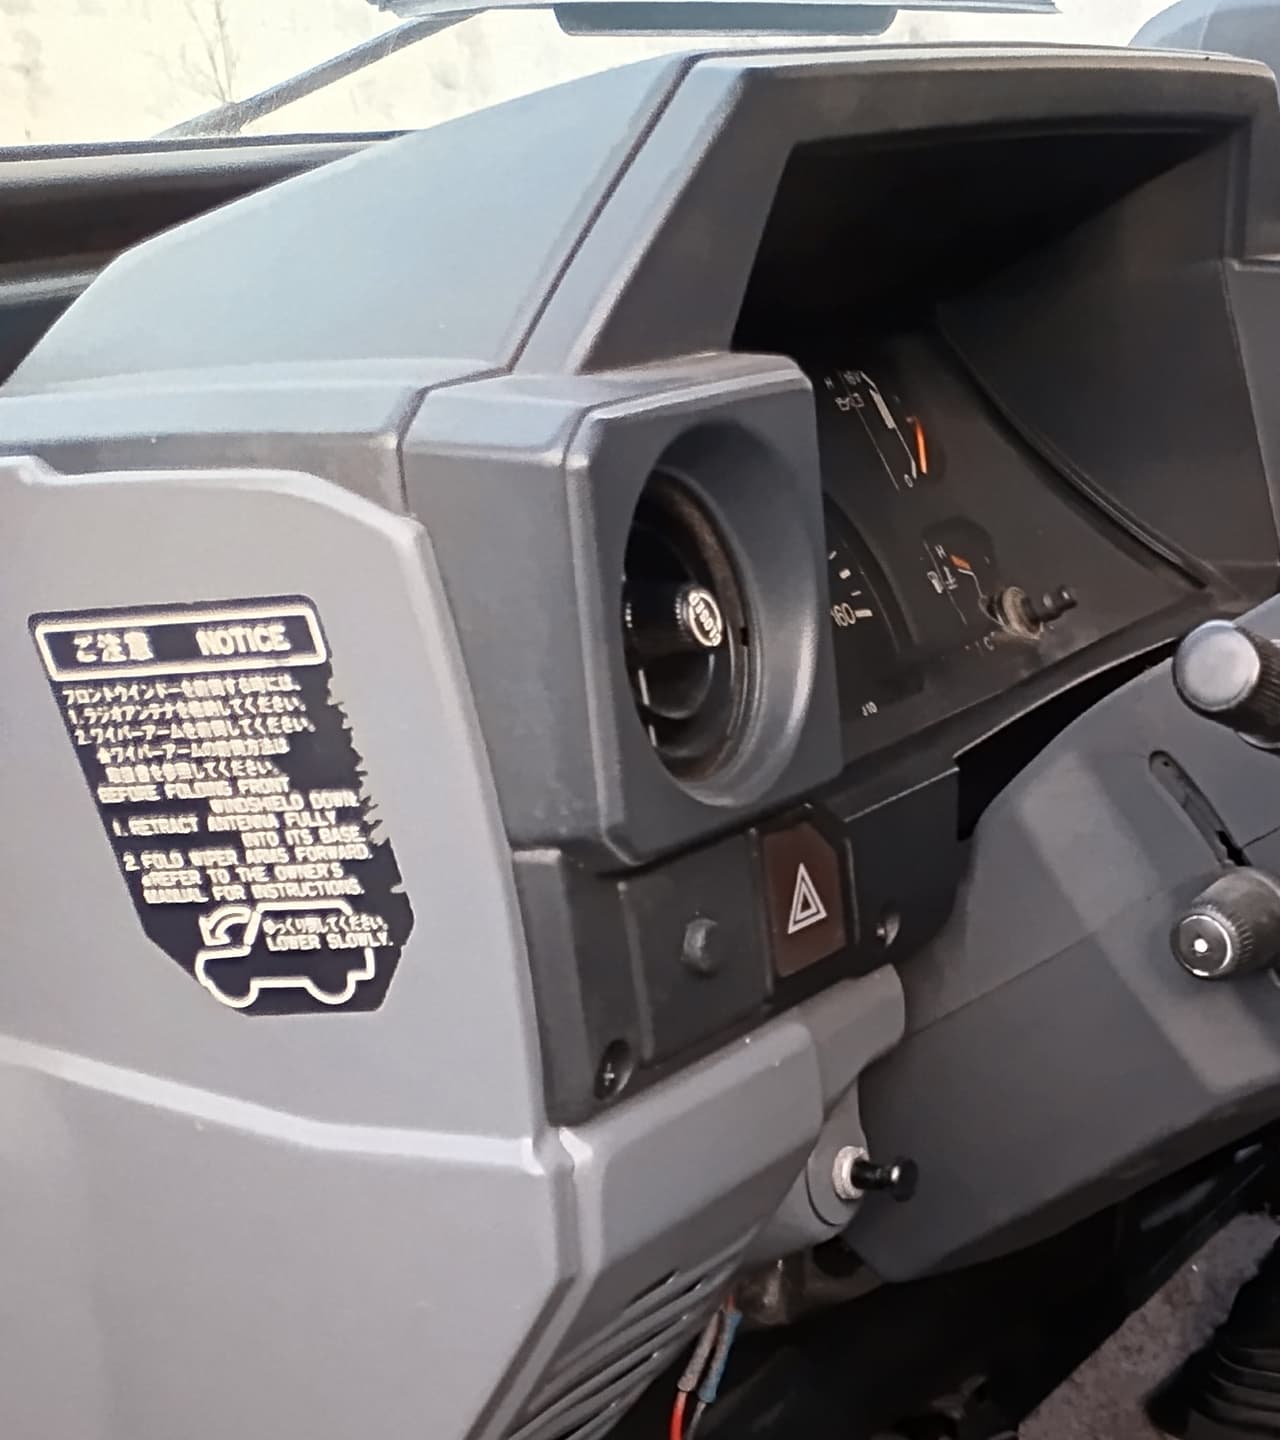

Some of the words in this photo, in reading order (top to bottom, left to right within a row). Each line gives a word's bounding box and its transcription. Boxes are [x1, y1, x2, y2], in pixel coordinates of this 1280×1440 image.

[830, 602, 856, 627] 160
[195, 624, 291, 656] NOTICE
[97, 785, 161, 803] BEFORE
[164, 781, 232, 799] FOLDING
[237, 777, 290, 794] FRONT
[209, 794, 304, 814] WINDSHIELD
[129, 815, 199, 836] RETRACT
[207, 814, 280, 832] ANTENNA
[284, 810, 336, 828] FULLY
[241, 831, 280, 848] INTO
[285, 828, 314, 846] ITS
[141, 851, 184, 869] FOLD
[189, 849, 238, 867] WIPER
[245, 847, 289, 865] ARMS
[207, 868, 230, 884] TO
[235, 866, 269, 883] THE
[144, 887, 209, 904] MANUAL
[212, 884, 246, 901] FOR
[266, 934, 322, 952] LOWER
